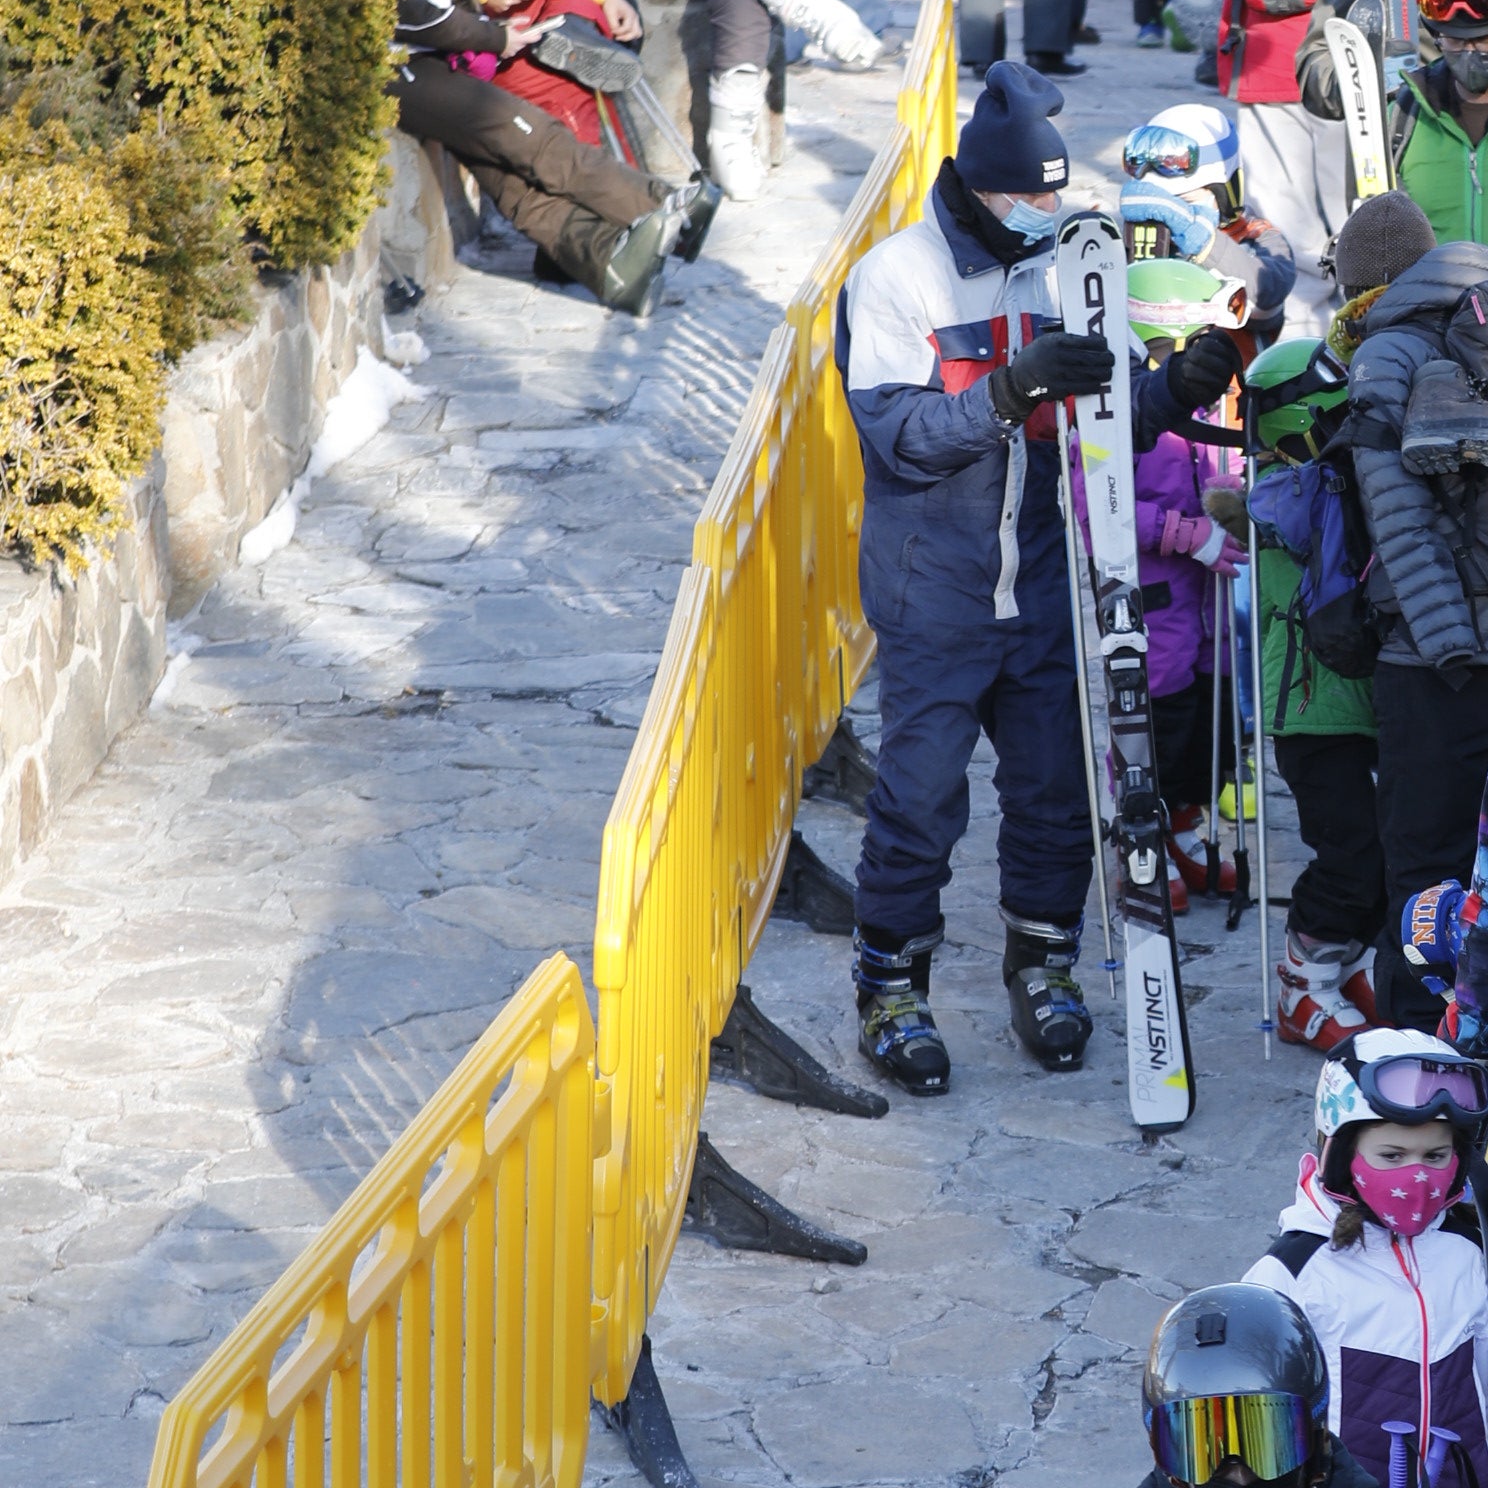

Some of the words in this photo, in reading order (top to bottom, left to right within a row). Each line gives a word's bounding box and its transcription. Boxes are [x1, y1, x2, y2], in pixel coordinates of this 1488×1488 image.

[1344, 47, 1369, 136] HEAD
[1083, 271, 1114, 422] HAD
[1143, 971, 1168, 1071] INSTINCT
